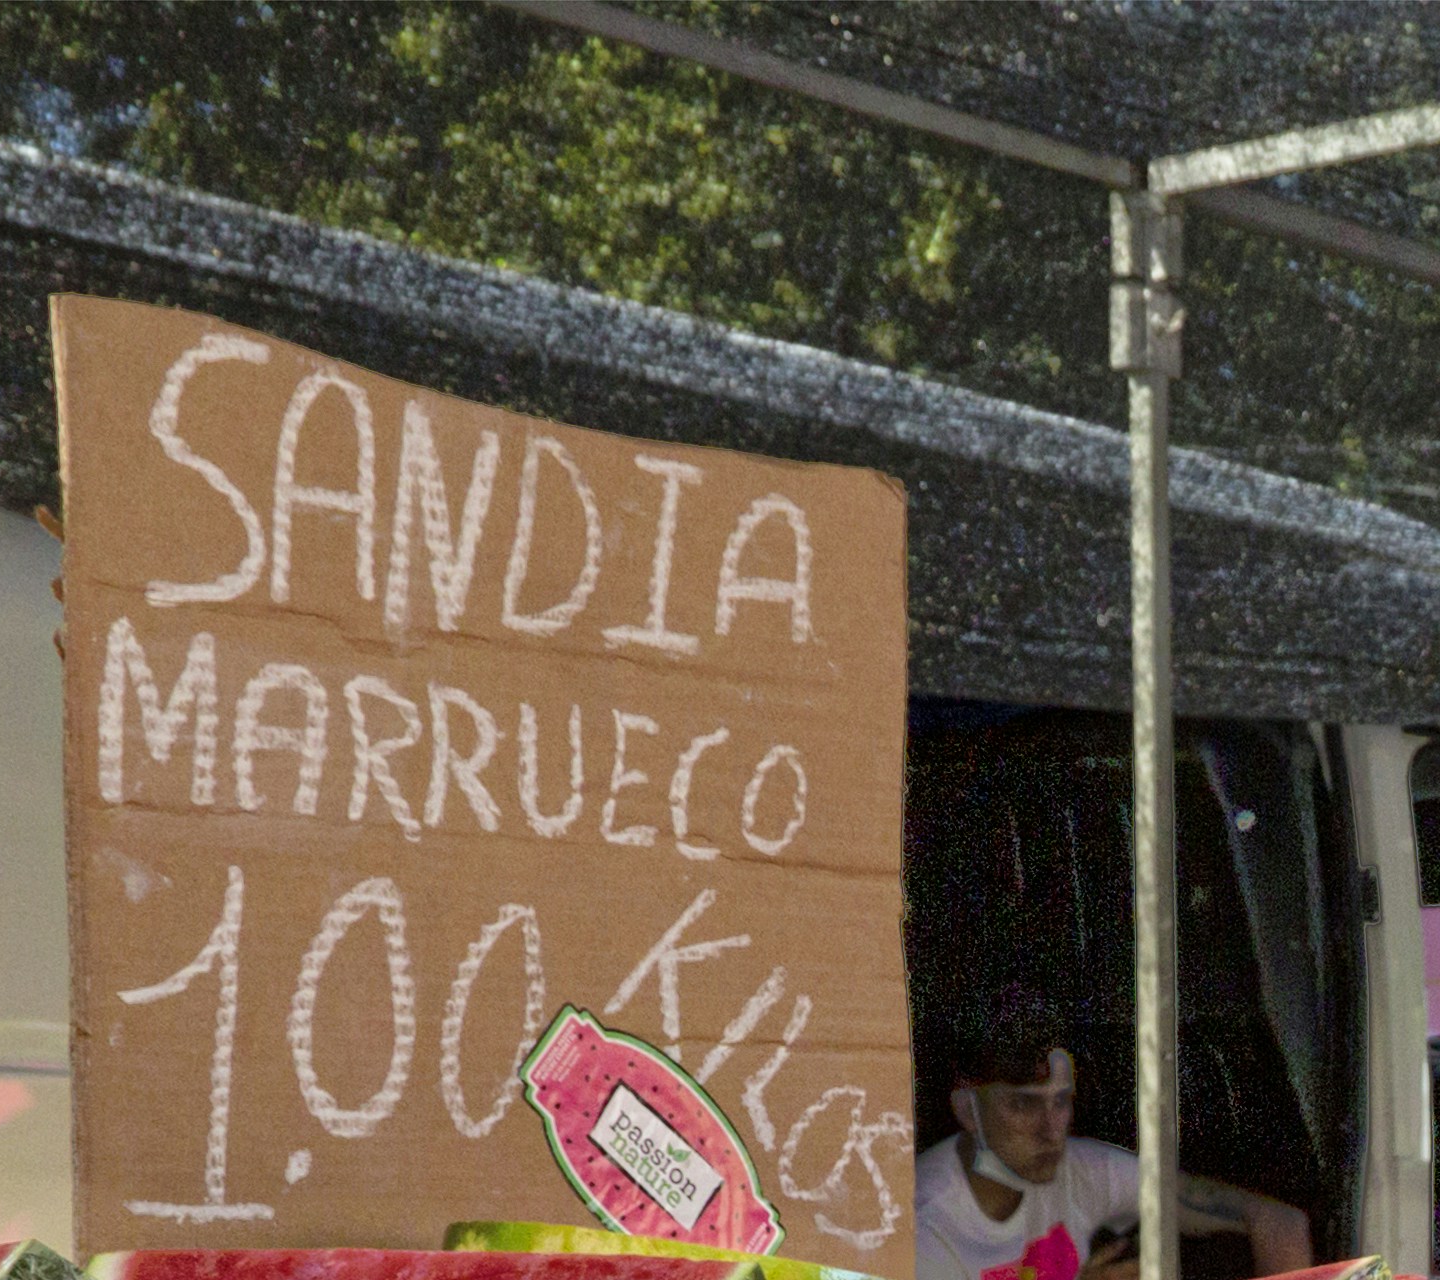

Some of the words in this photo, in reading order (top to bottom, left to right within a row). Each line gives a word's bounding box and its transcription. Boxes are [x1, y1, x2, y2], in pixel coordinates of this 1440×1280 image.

[148, 332, 814, 656] SANDIA
[96, 617, 807, 861] MARRUECO
[117, 864, 547, 1222] 1.00
[610, 1110, 696, 1200] passion
[609, 1133, 681, 1208] nature
